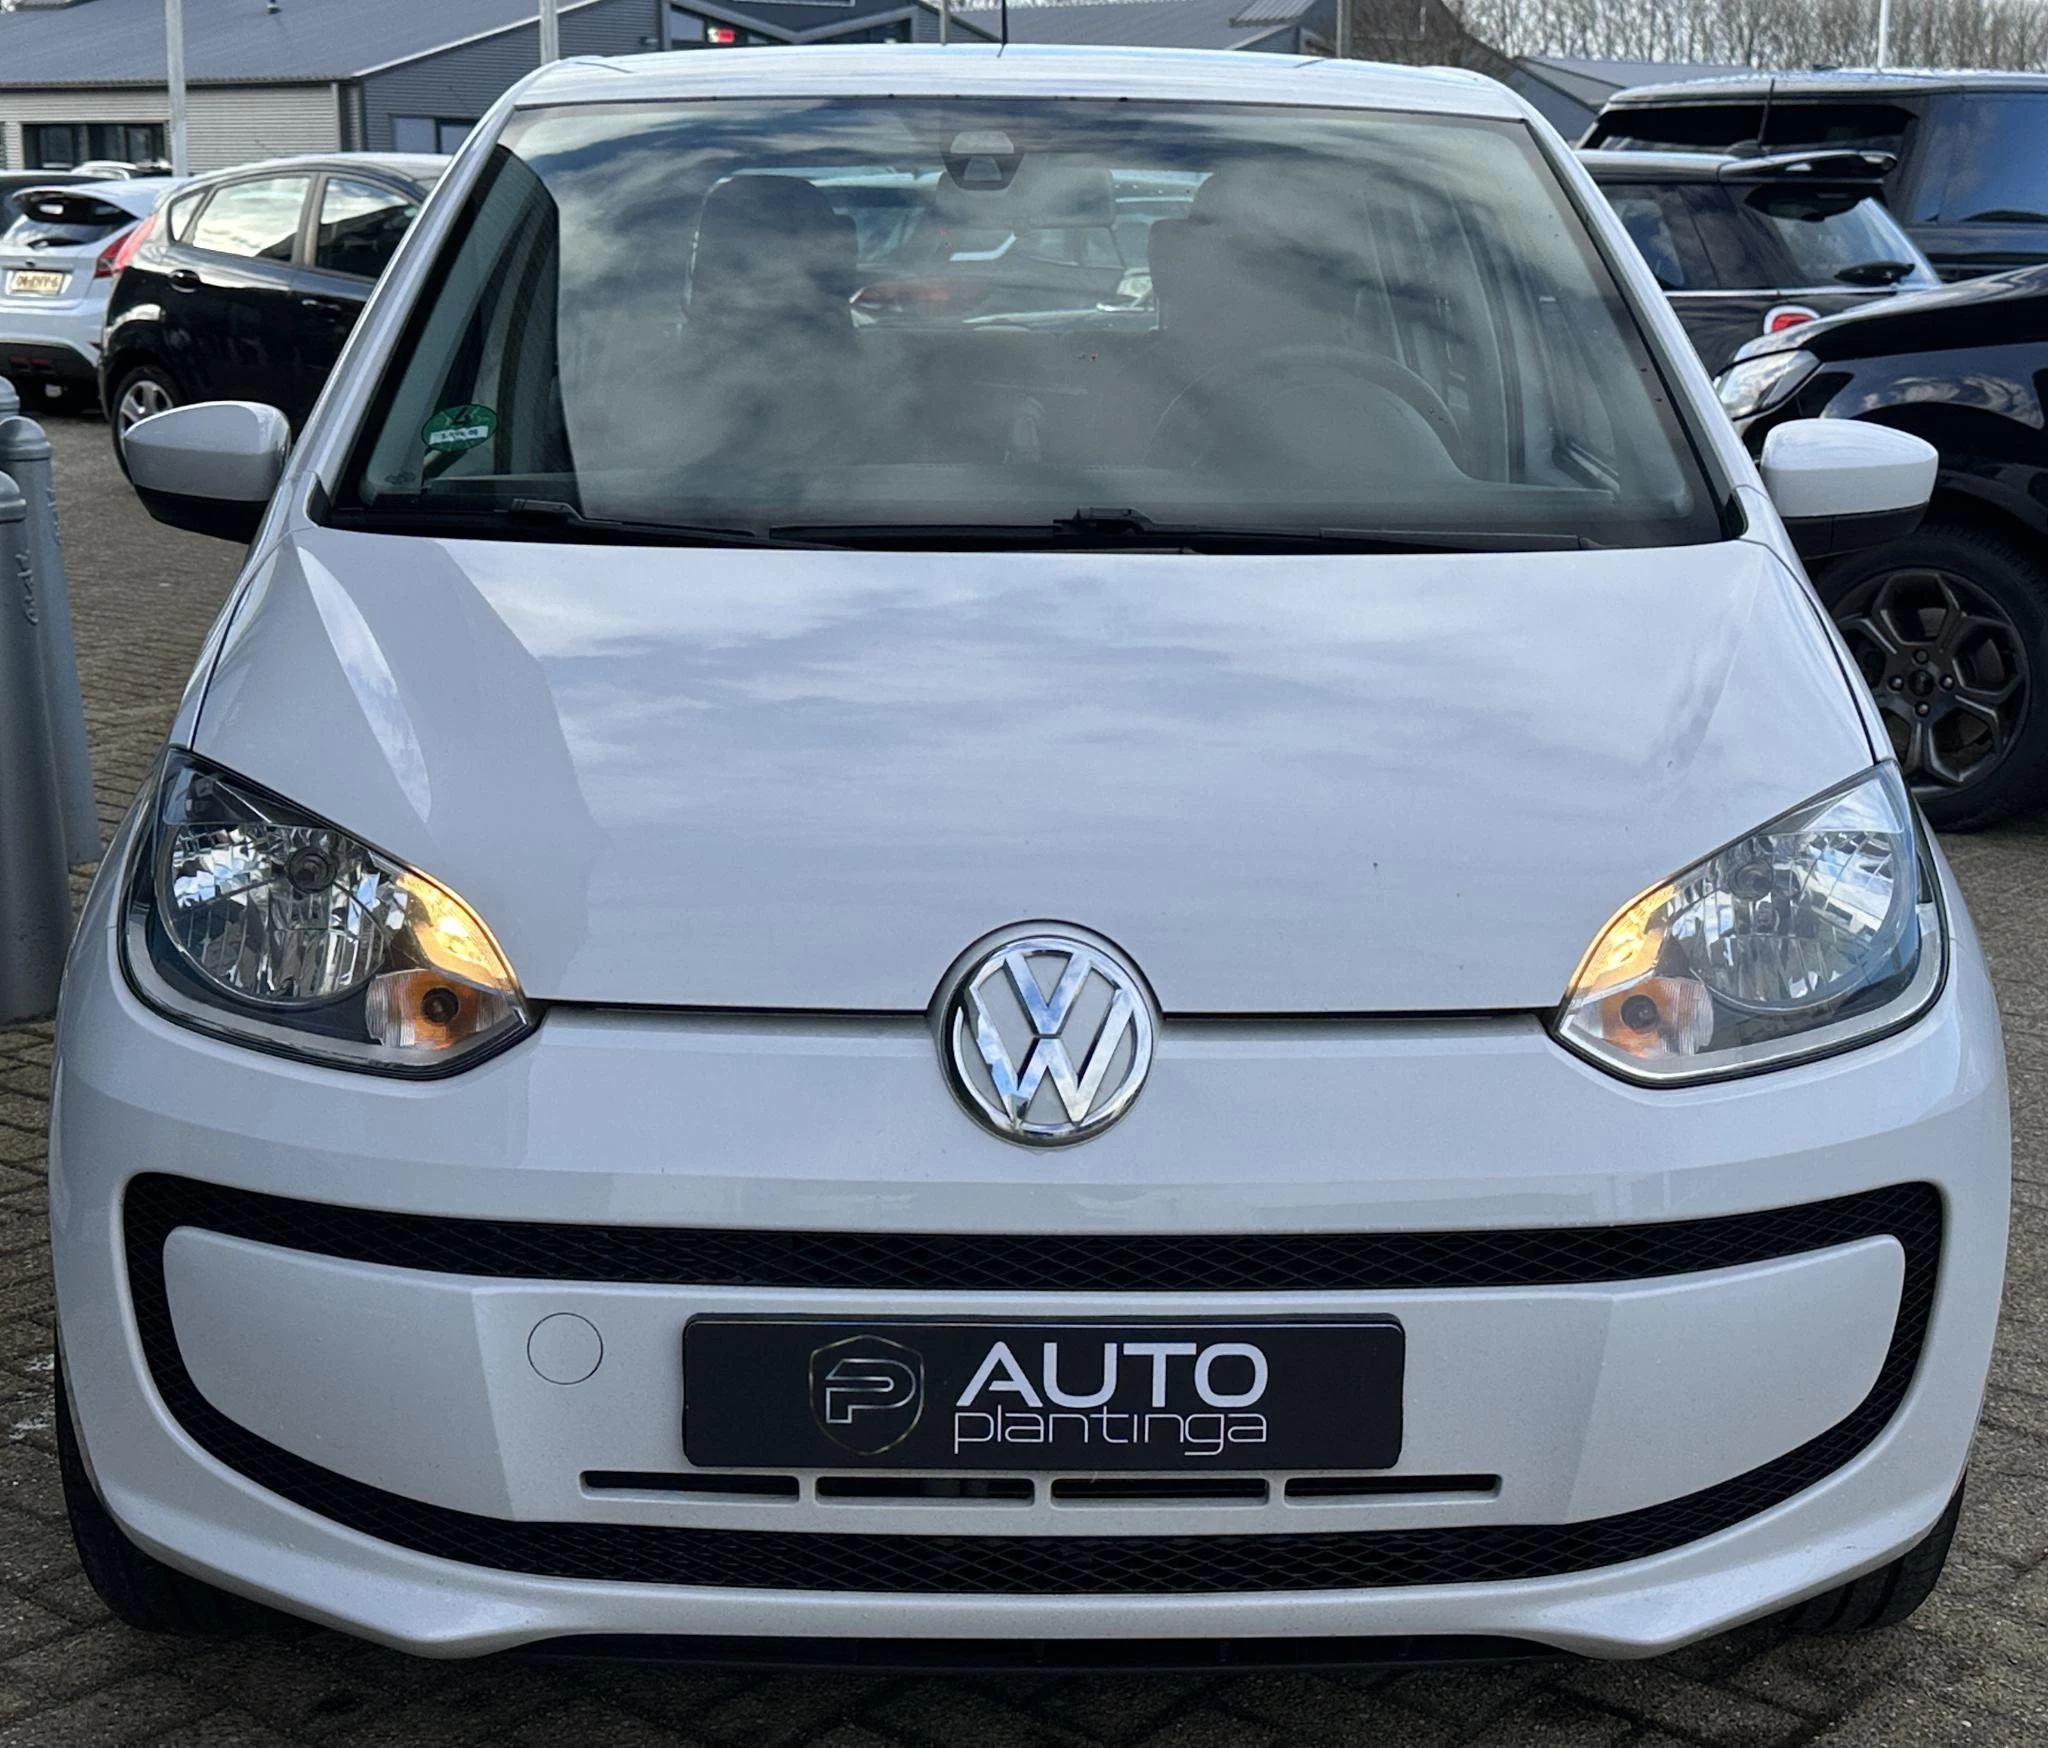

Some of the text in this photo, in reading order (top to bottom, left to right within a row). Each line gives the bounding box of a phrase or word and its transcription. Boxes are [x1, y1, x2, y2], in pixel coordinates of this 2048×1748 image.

[453, 407, 471, 427] 4
[965, 946, 1136, 1130] VW
[825, 1358, 916, 1424] P
[955, 1341, 1268, 1408] AUTO
[954, 1405, 1267, 1456] plantinga
